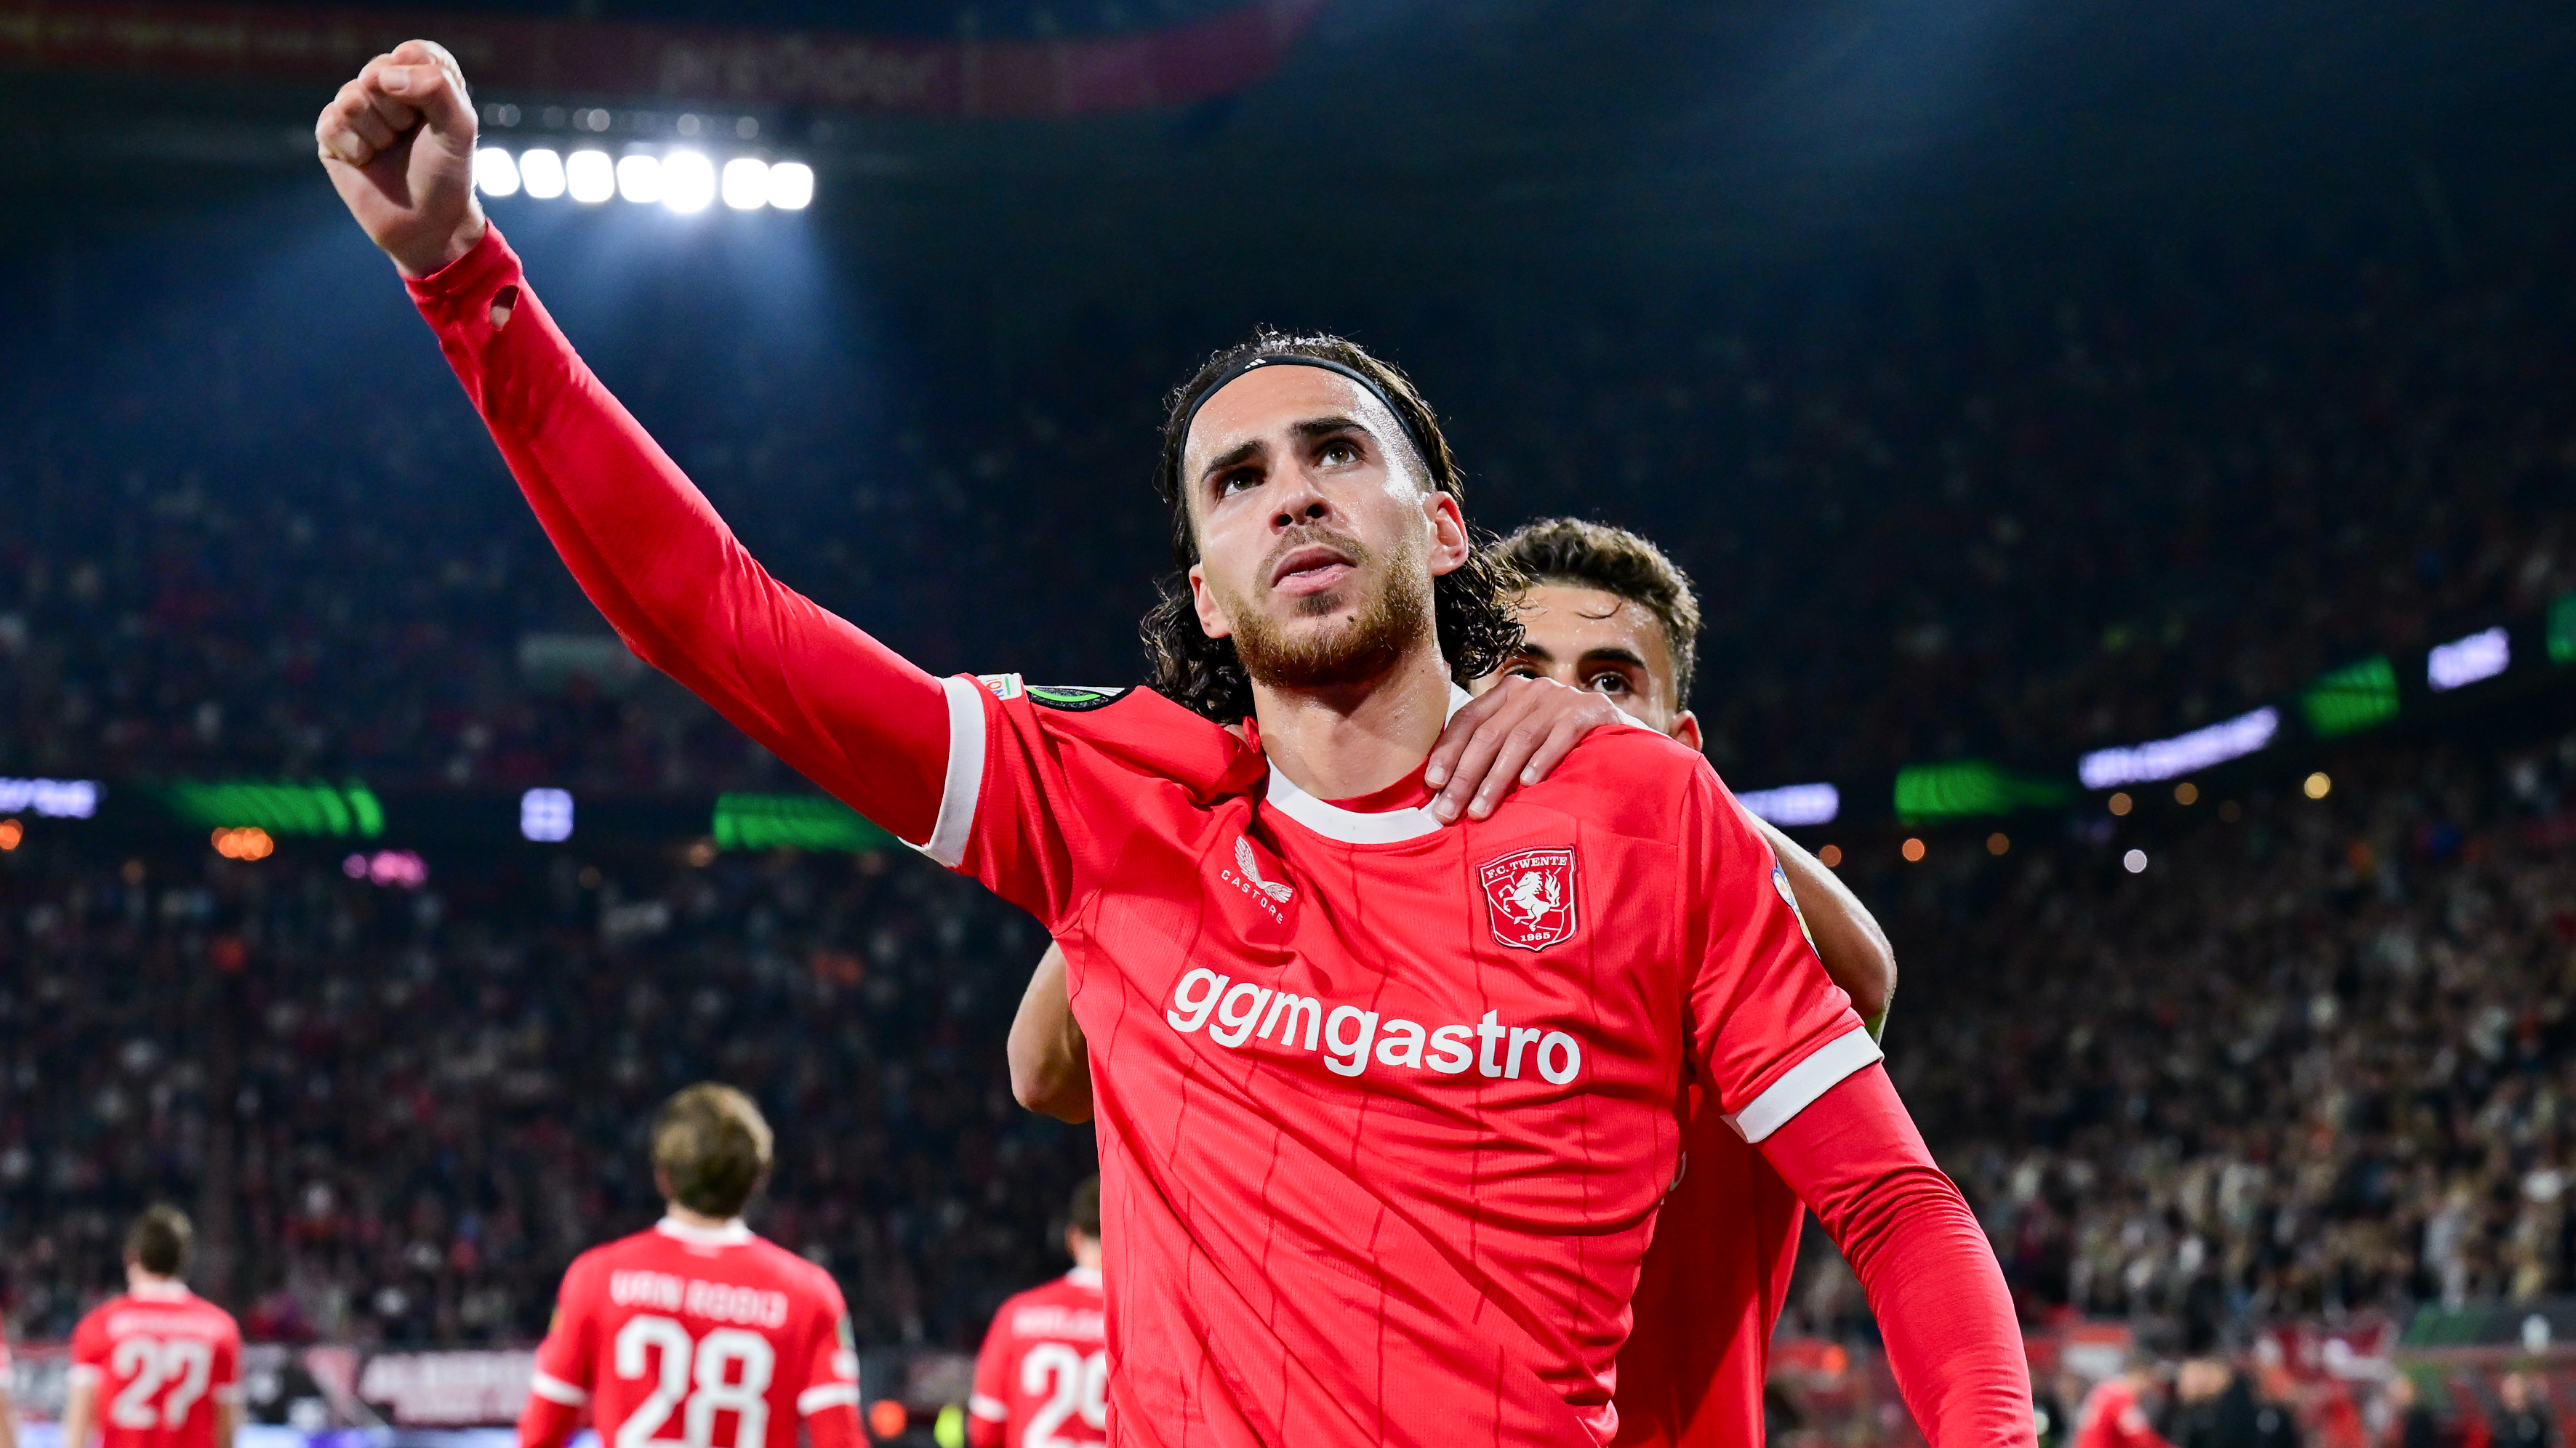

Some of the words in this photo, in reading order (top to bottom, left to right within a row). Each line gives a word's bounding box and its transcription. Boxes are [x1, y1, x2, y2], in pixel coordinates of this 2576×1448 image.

[1485, 865, 1509, 880] F.C.
[1510, 856, 1568, 871] TWENTE
[1221, 869, 1284, 924] CASTORE
[1520, 932, 1551, 942] 1965
[1165, 968, 1581, 1085] ggmgastro
[610, 1270, 684, 1311] VAN
[112, 1338, 212, 1429] 27
[615, 1314, 776, 1447] 28
